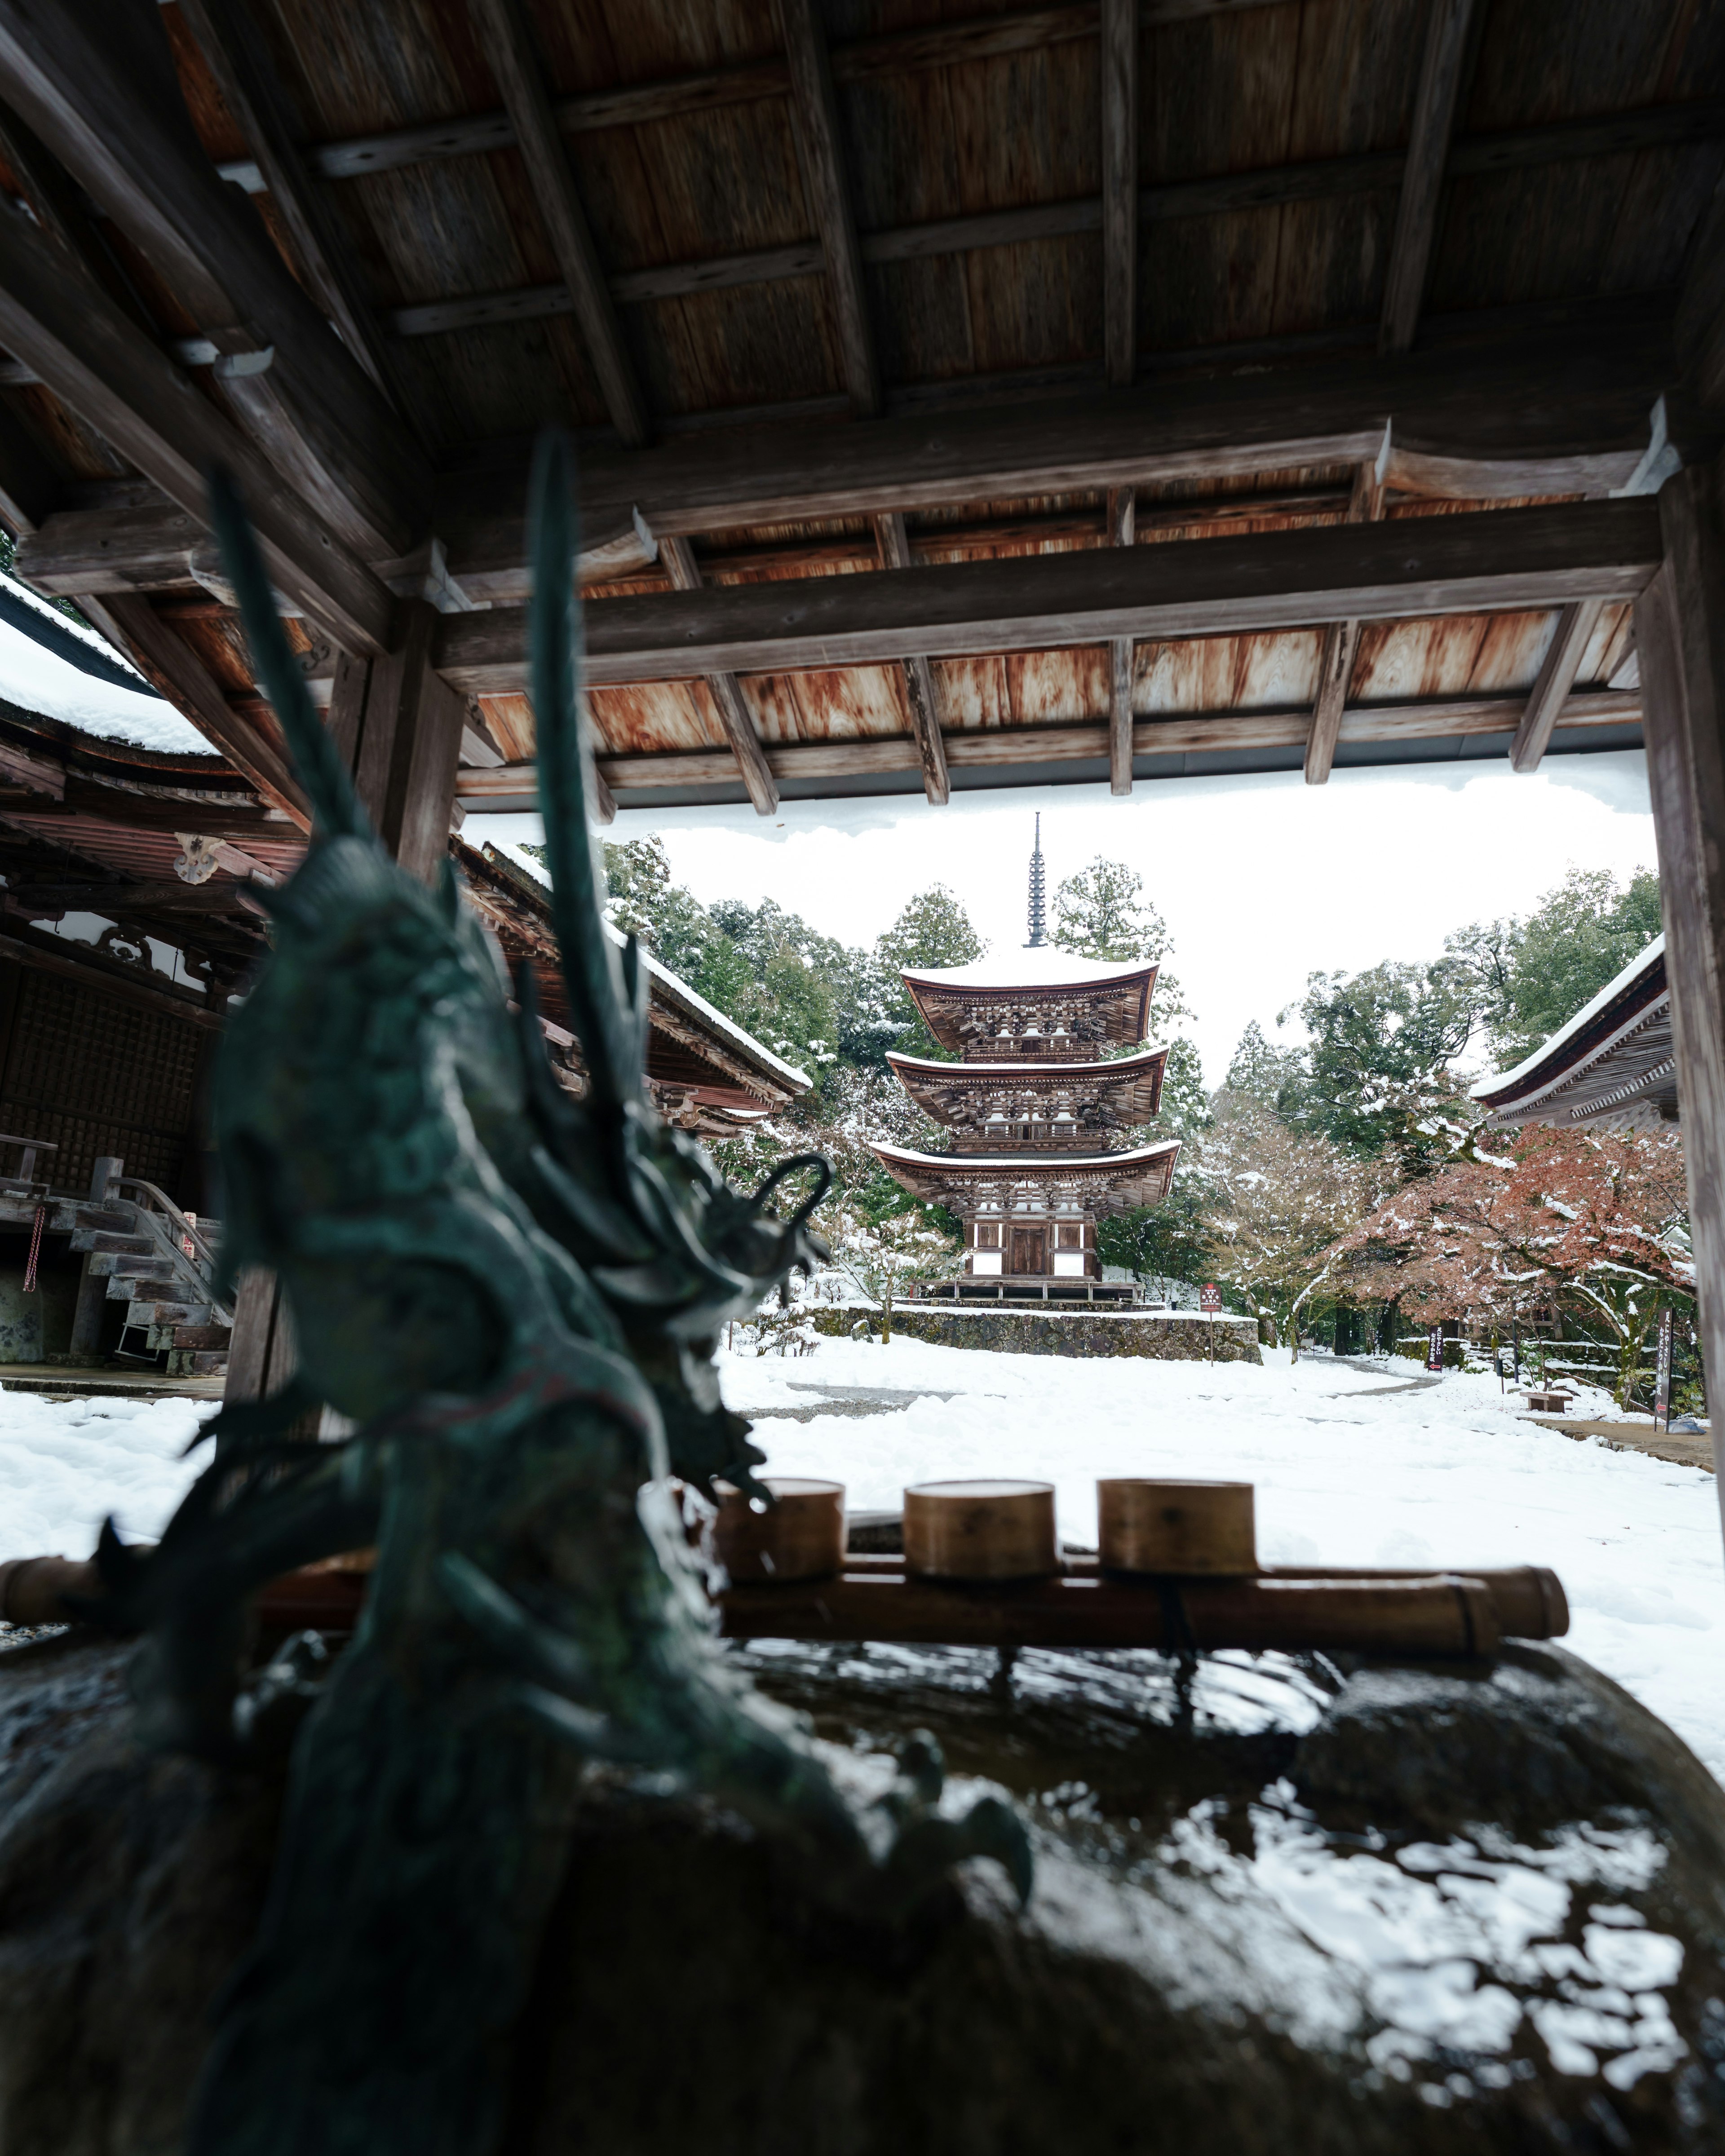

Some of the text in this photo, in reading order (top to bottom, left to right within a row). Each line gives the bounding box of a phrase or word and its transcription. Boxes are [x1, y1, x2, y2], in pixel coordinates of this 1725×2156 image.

[1656, 1326, 1664, 1396] なだらかな坂
